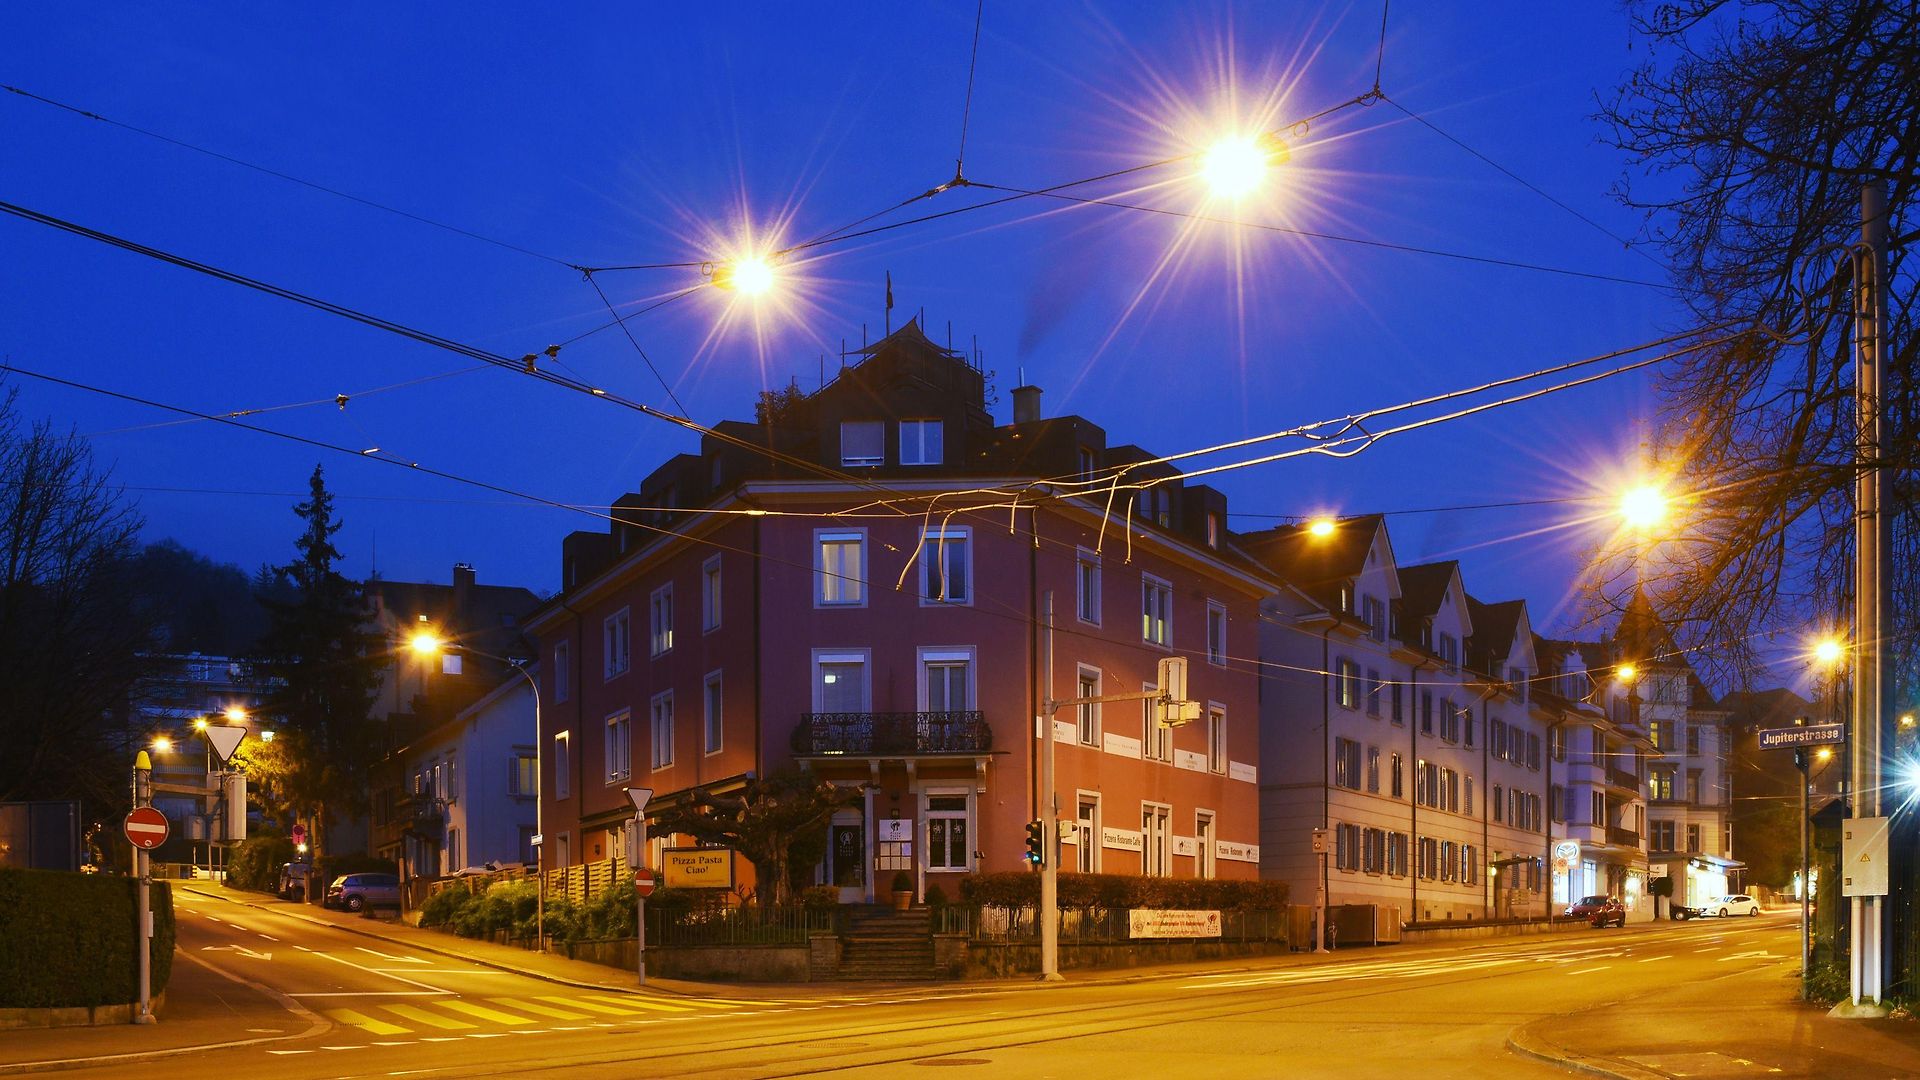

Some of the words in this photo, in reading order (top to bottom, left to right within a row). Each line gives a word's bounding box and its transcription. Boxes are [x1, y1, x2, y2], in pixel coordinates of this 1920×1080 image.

[1763, 729, 1839, 745] Jupiterstrasse
[672, 856, 696, 865] Pizza
[698, 856, 723, 864] Pasta
